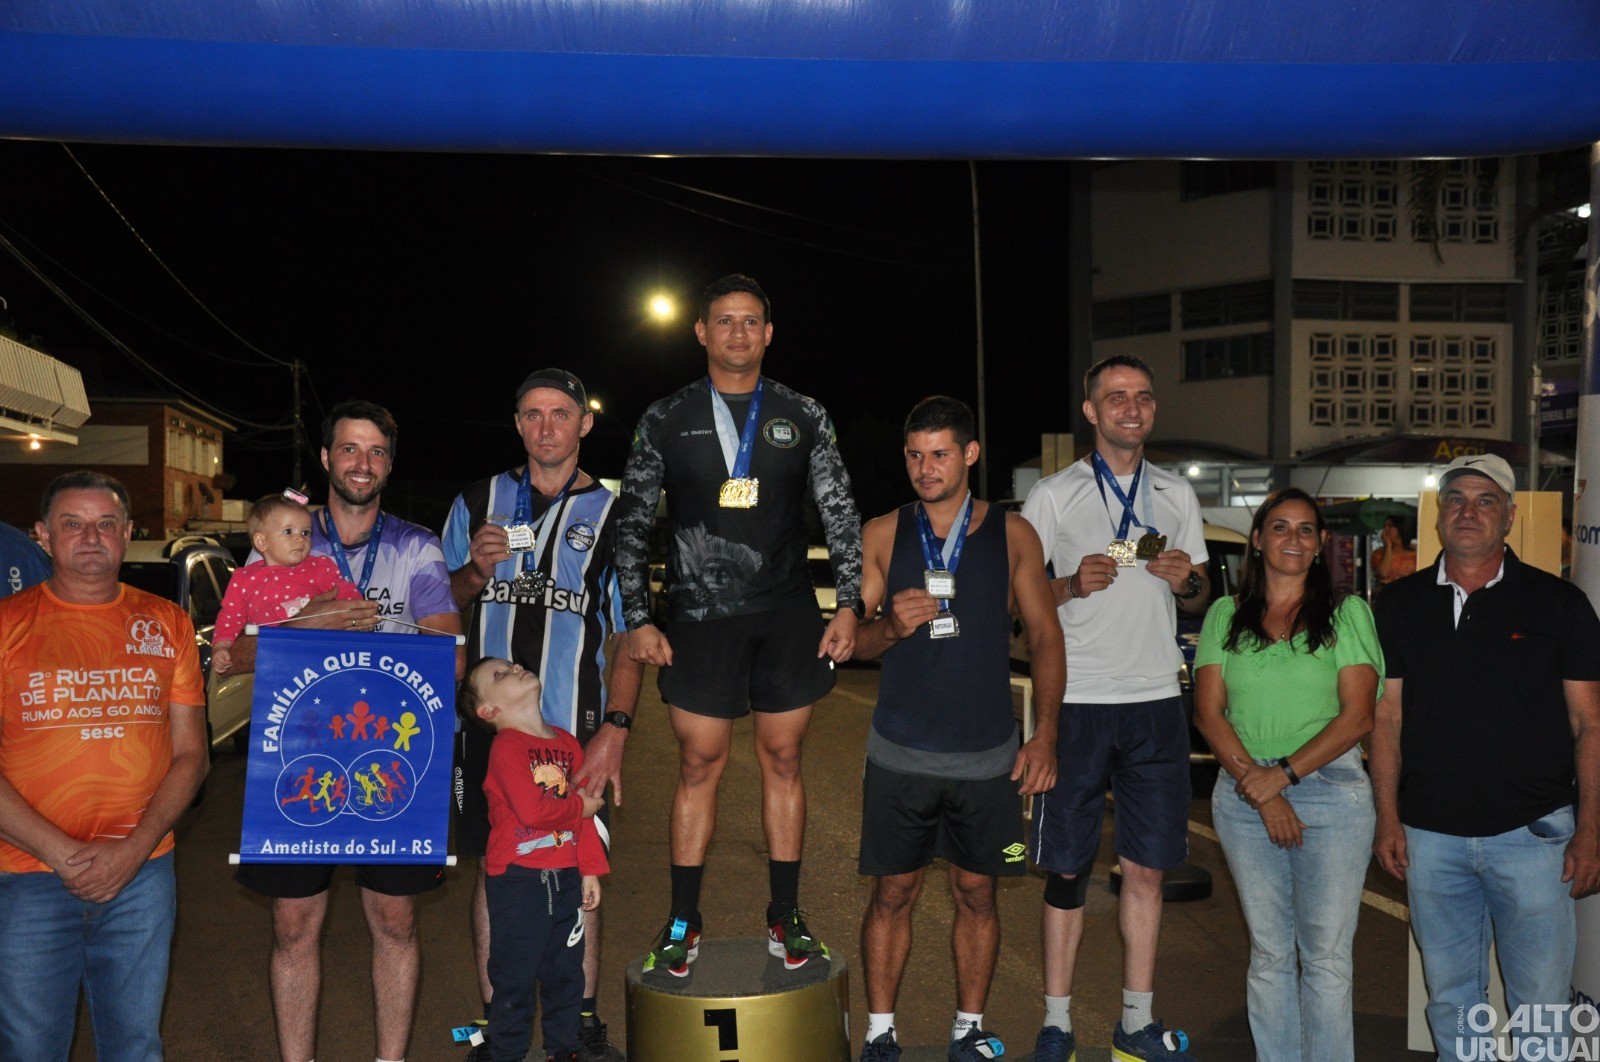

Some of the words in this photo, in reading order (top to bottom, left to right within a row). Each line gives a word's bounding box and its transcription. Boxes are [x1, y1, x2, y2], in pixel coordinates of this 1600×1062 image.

[480, 576, 590, 616] Baisul
[56, 667, 157, 685] RÚSTICA
[20, 690, 47, 706] DE
[53, 685, 161, 703] PLANALTO
[263, 667, 320, 753] FAMÍLIA
[323, 652, 372, 672] QUE
[379, 655, 443, 713] CORRE
[22, 709, 63, 723] RUMO
[66, 706, 103, 719] AOS
[107, 705, 130, 717] 60
[134, 704, 162, 716] ANOS
[80, 726, 125, 741] sesc
[260, 838, 342, 855] Ametista
[344, 838, 365, 855] do
[370, 838, 396, 855] Sul
[412, 839, 433, 855] RS
[704, 1008, 739, 1062] 1
